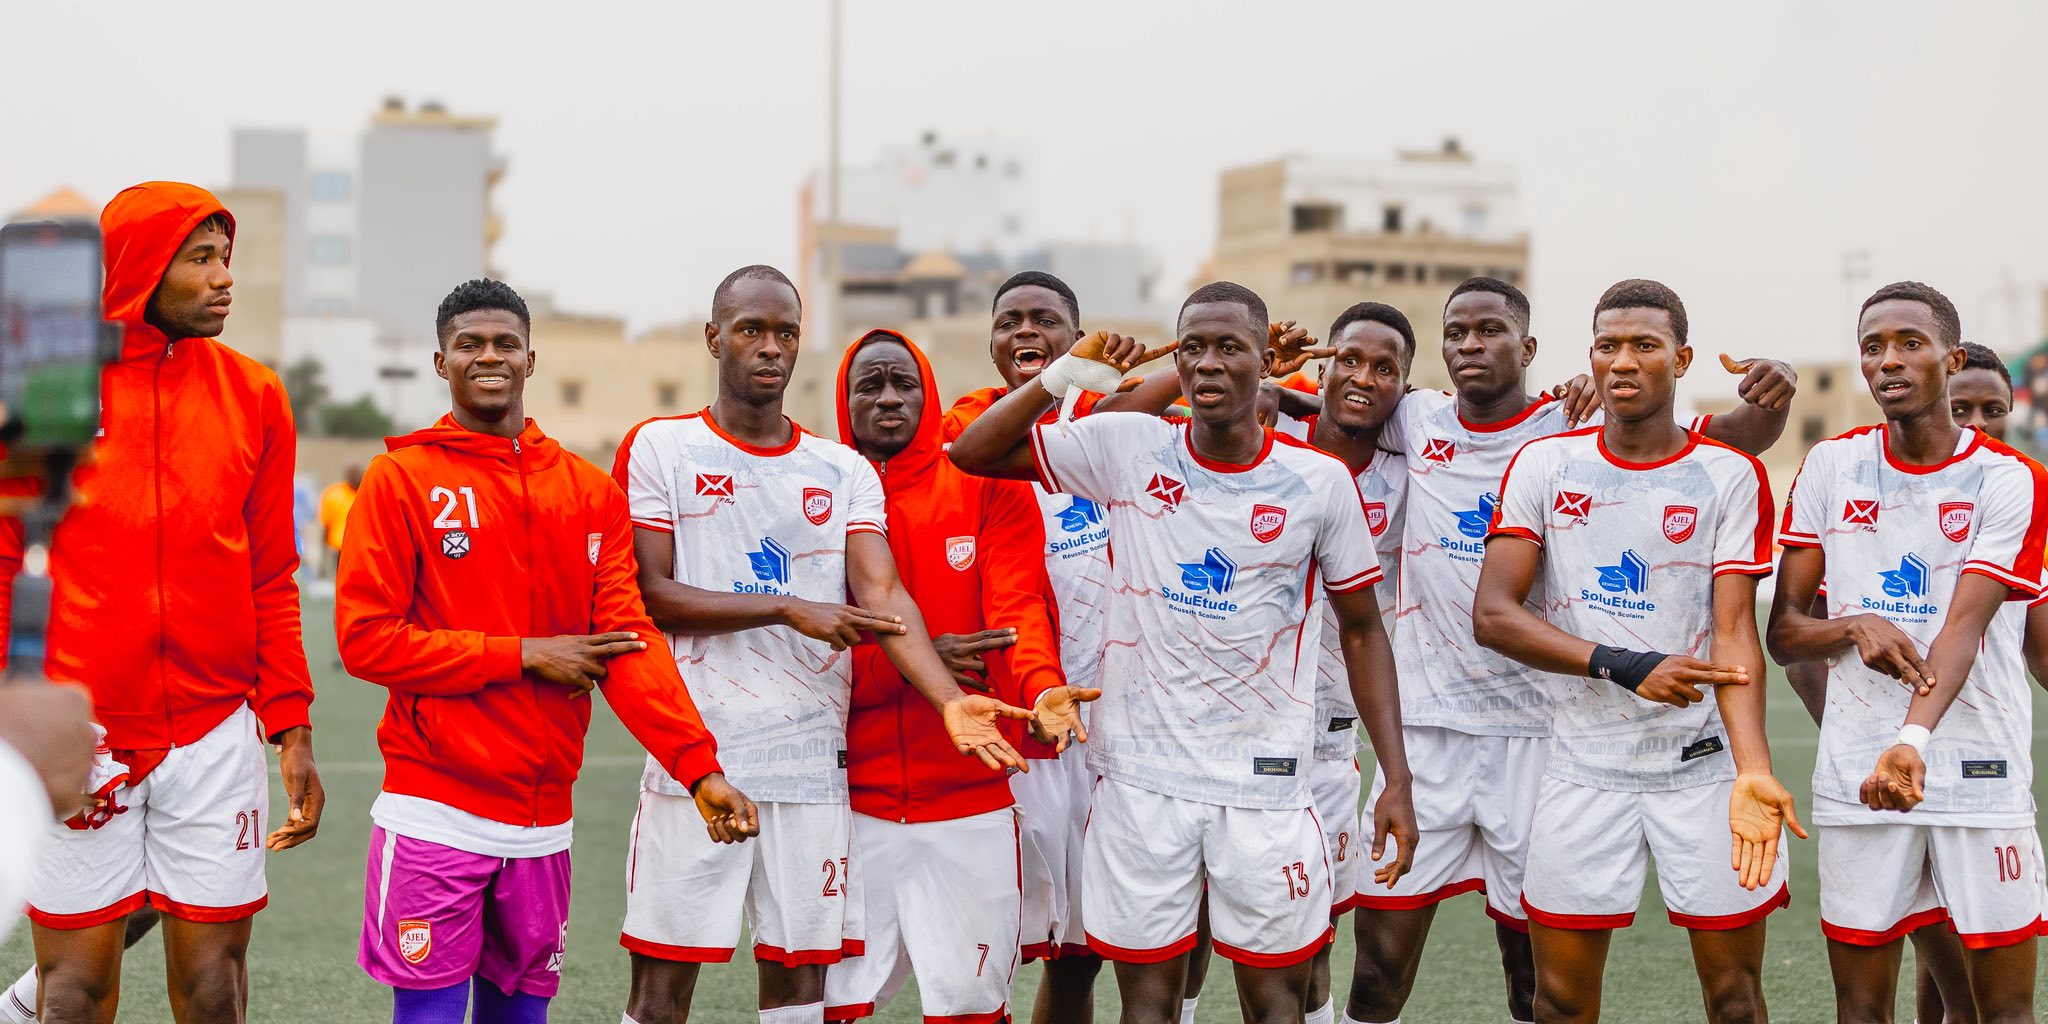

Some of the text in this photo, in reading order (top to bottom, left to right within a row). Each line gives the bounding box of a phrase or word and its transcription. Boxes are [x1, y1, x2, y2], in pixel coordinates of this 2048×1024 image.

[430, 485, 480, 529] 21
[812, 498, 828, 507] AJEL
[1260, 515, 1280, 525] AJEL
[1370, 511, 1383, 519] JEL
[1672, 515, 1691, 524] AJEL
[1949, 513, 1969, 521] AJEL
[953, 545, 971, 553] AJEL
[1440, 536, 1484, 554] SoluE
[1448, 552, 1479, 564] Réussite
[1162, 586, 1238, 612] SoluEtude
[1581, 589, 1656, 612] SoluEtude
[1861, 597, 1938, 615] SoluEtude
[1197, 611, 1226, 621] Scolaire
[1617, 611, 1645, 620] Scolaire
[1901, 616, 1928, 624] Scolaire
[235, 809, 260, 851] 21
[1994, 845, 2021, 882] 10
[1282, 861, 1310, 901] 13
[406, 932, 426, 942] AJEL
[976, 943, 990, 977] 7
